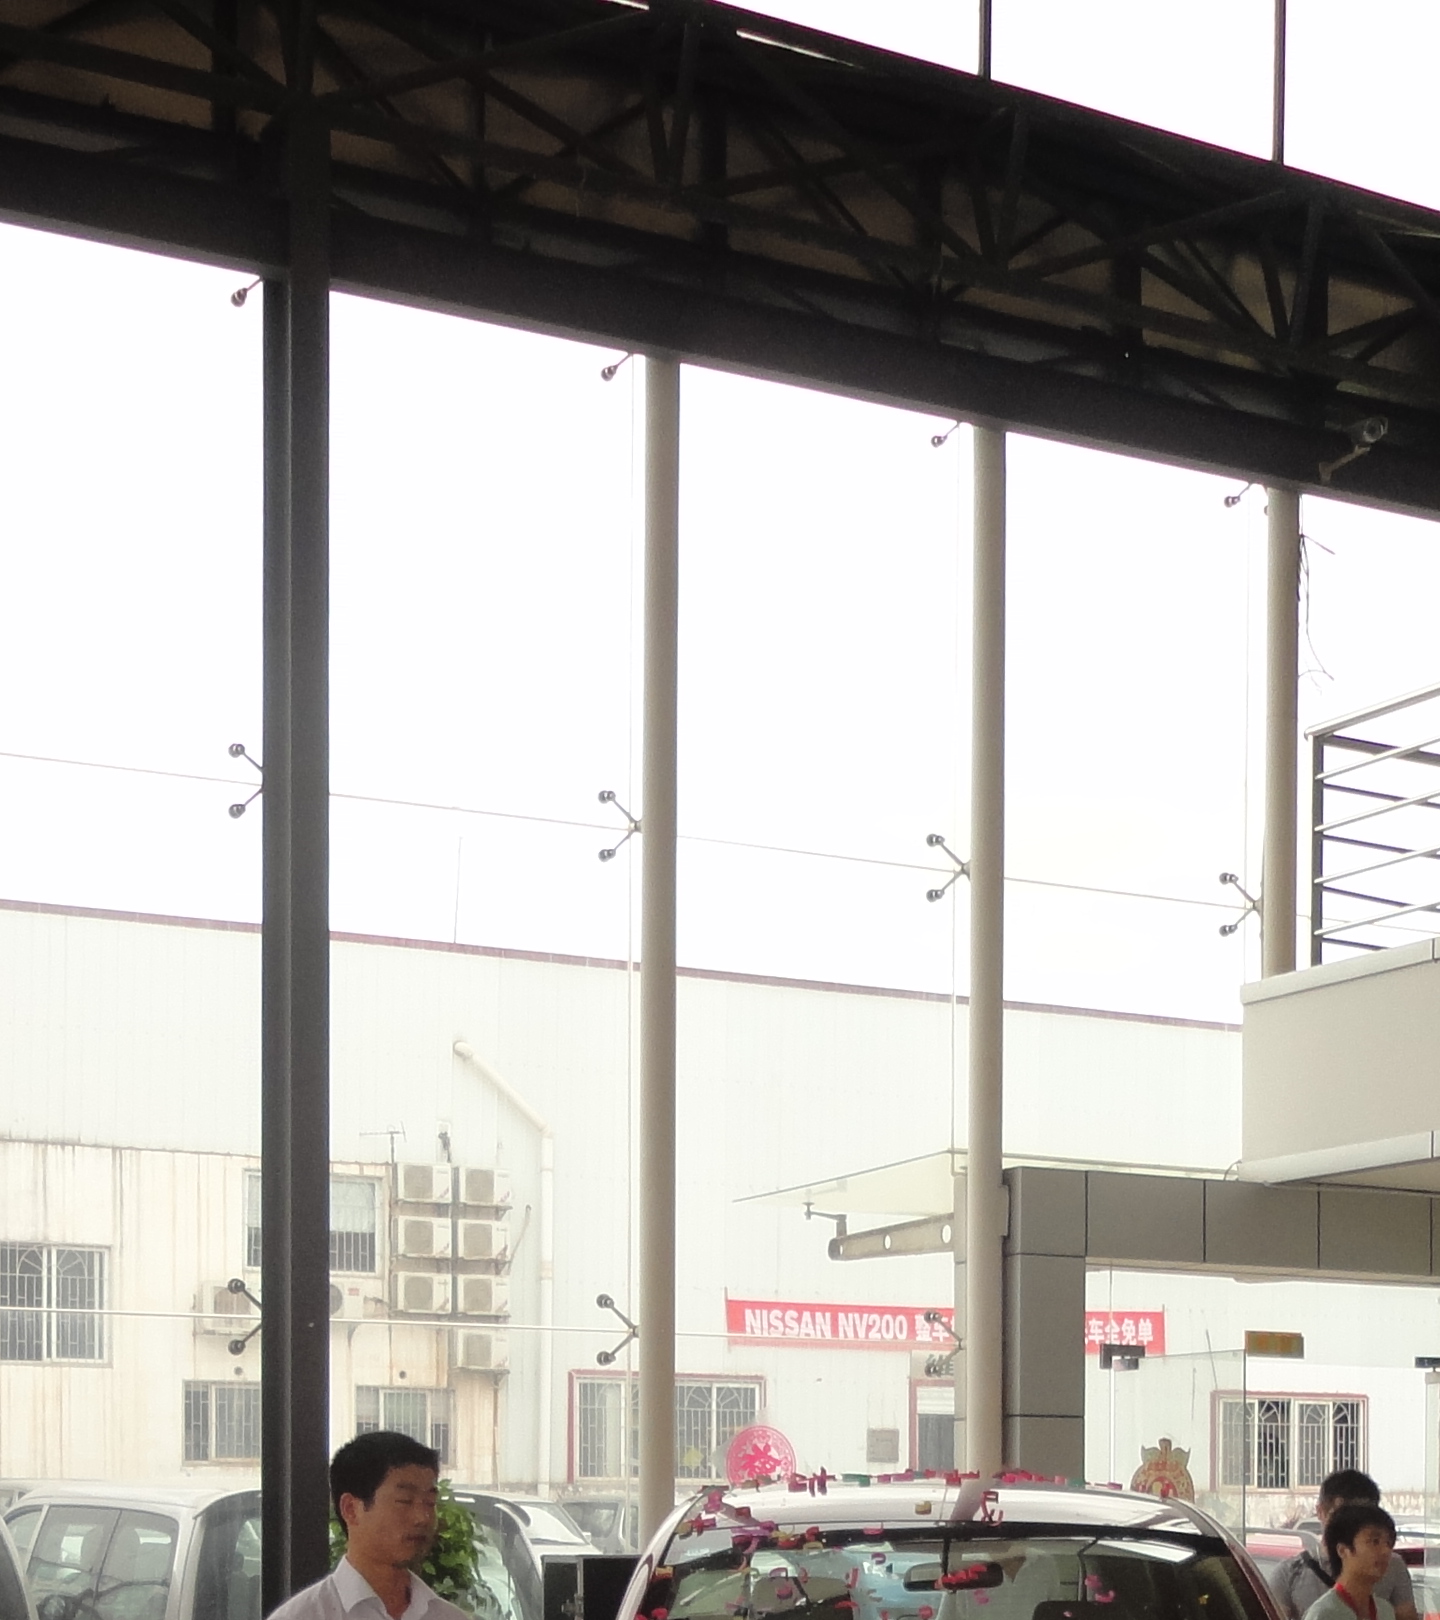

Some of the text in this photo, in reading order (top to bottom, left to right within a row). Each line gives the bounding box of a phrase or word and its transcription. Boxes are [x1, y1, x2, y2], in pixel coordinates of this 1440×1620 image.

[745, 1308, 954, 1342] NISSAN NV200 整车
[1085, 1317, 1153, 1346] 车全免单
